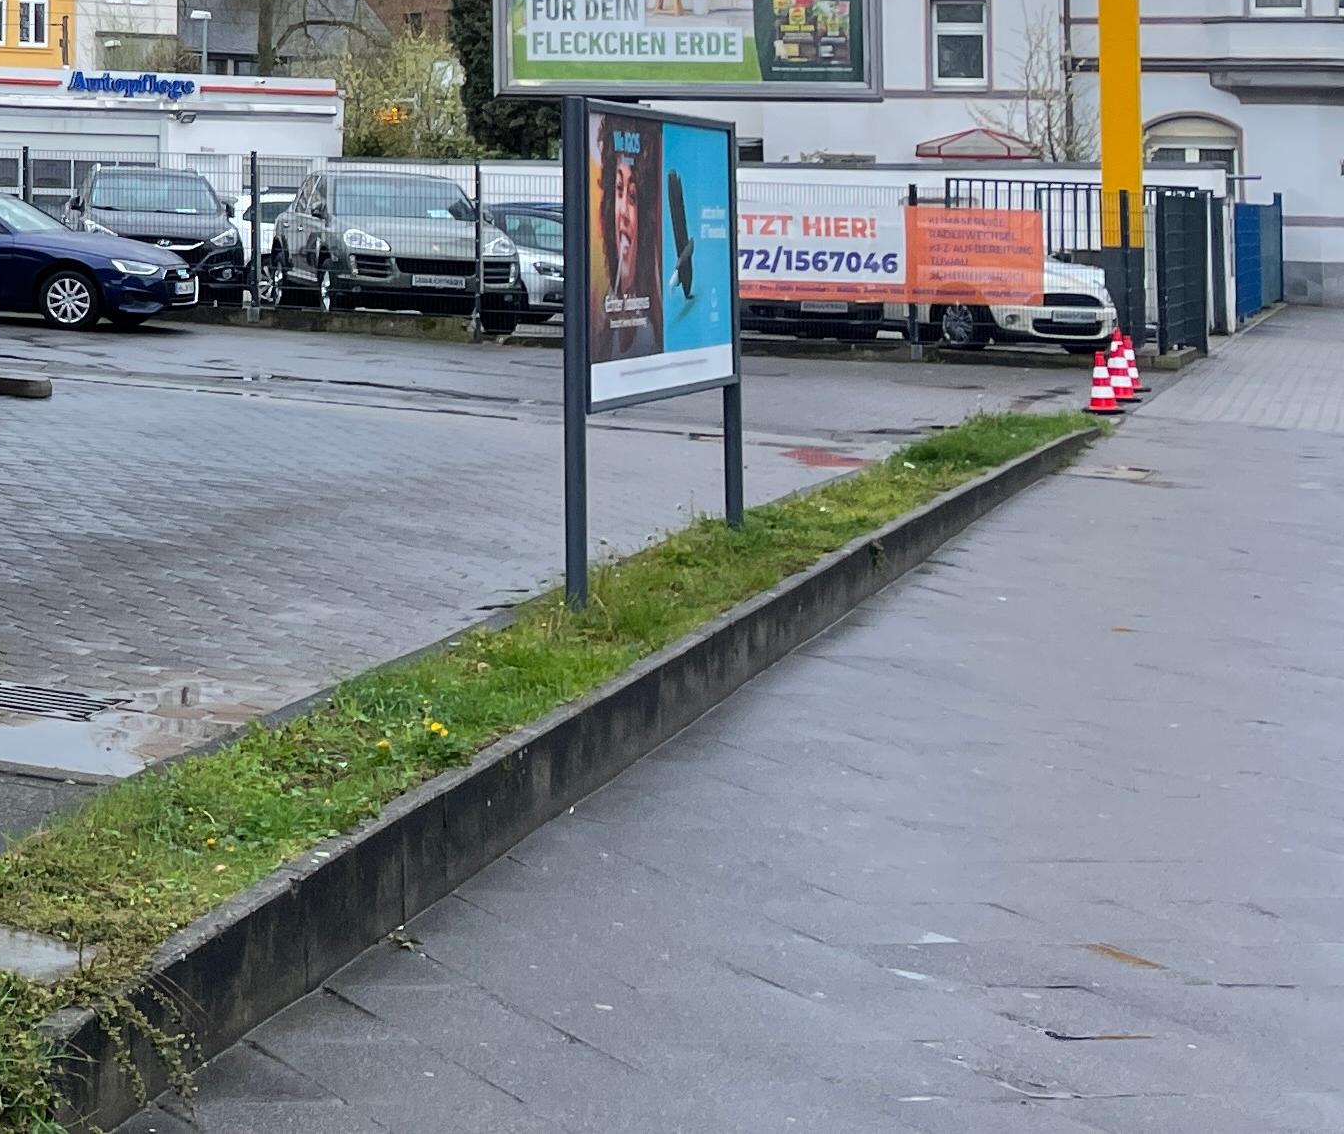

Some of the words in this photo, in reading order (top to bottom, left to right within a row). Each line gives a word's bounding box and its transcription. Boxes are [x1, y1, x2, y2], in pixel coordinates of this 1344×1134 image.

[532, 32, 666, 55] FLECKCHEN
[675, 32, 737, 56] ERDE
[67, 70, 195, 99] Autopflege
[738, 214, 792, 236] TZT
[802, 216, 877, 238] HIER!
[739, 246, 898, 273] 72/1567046
